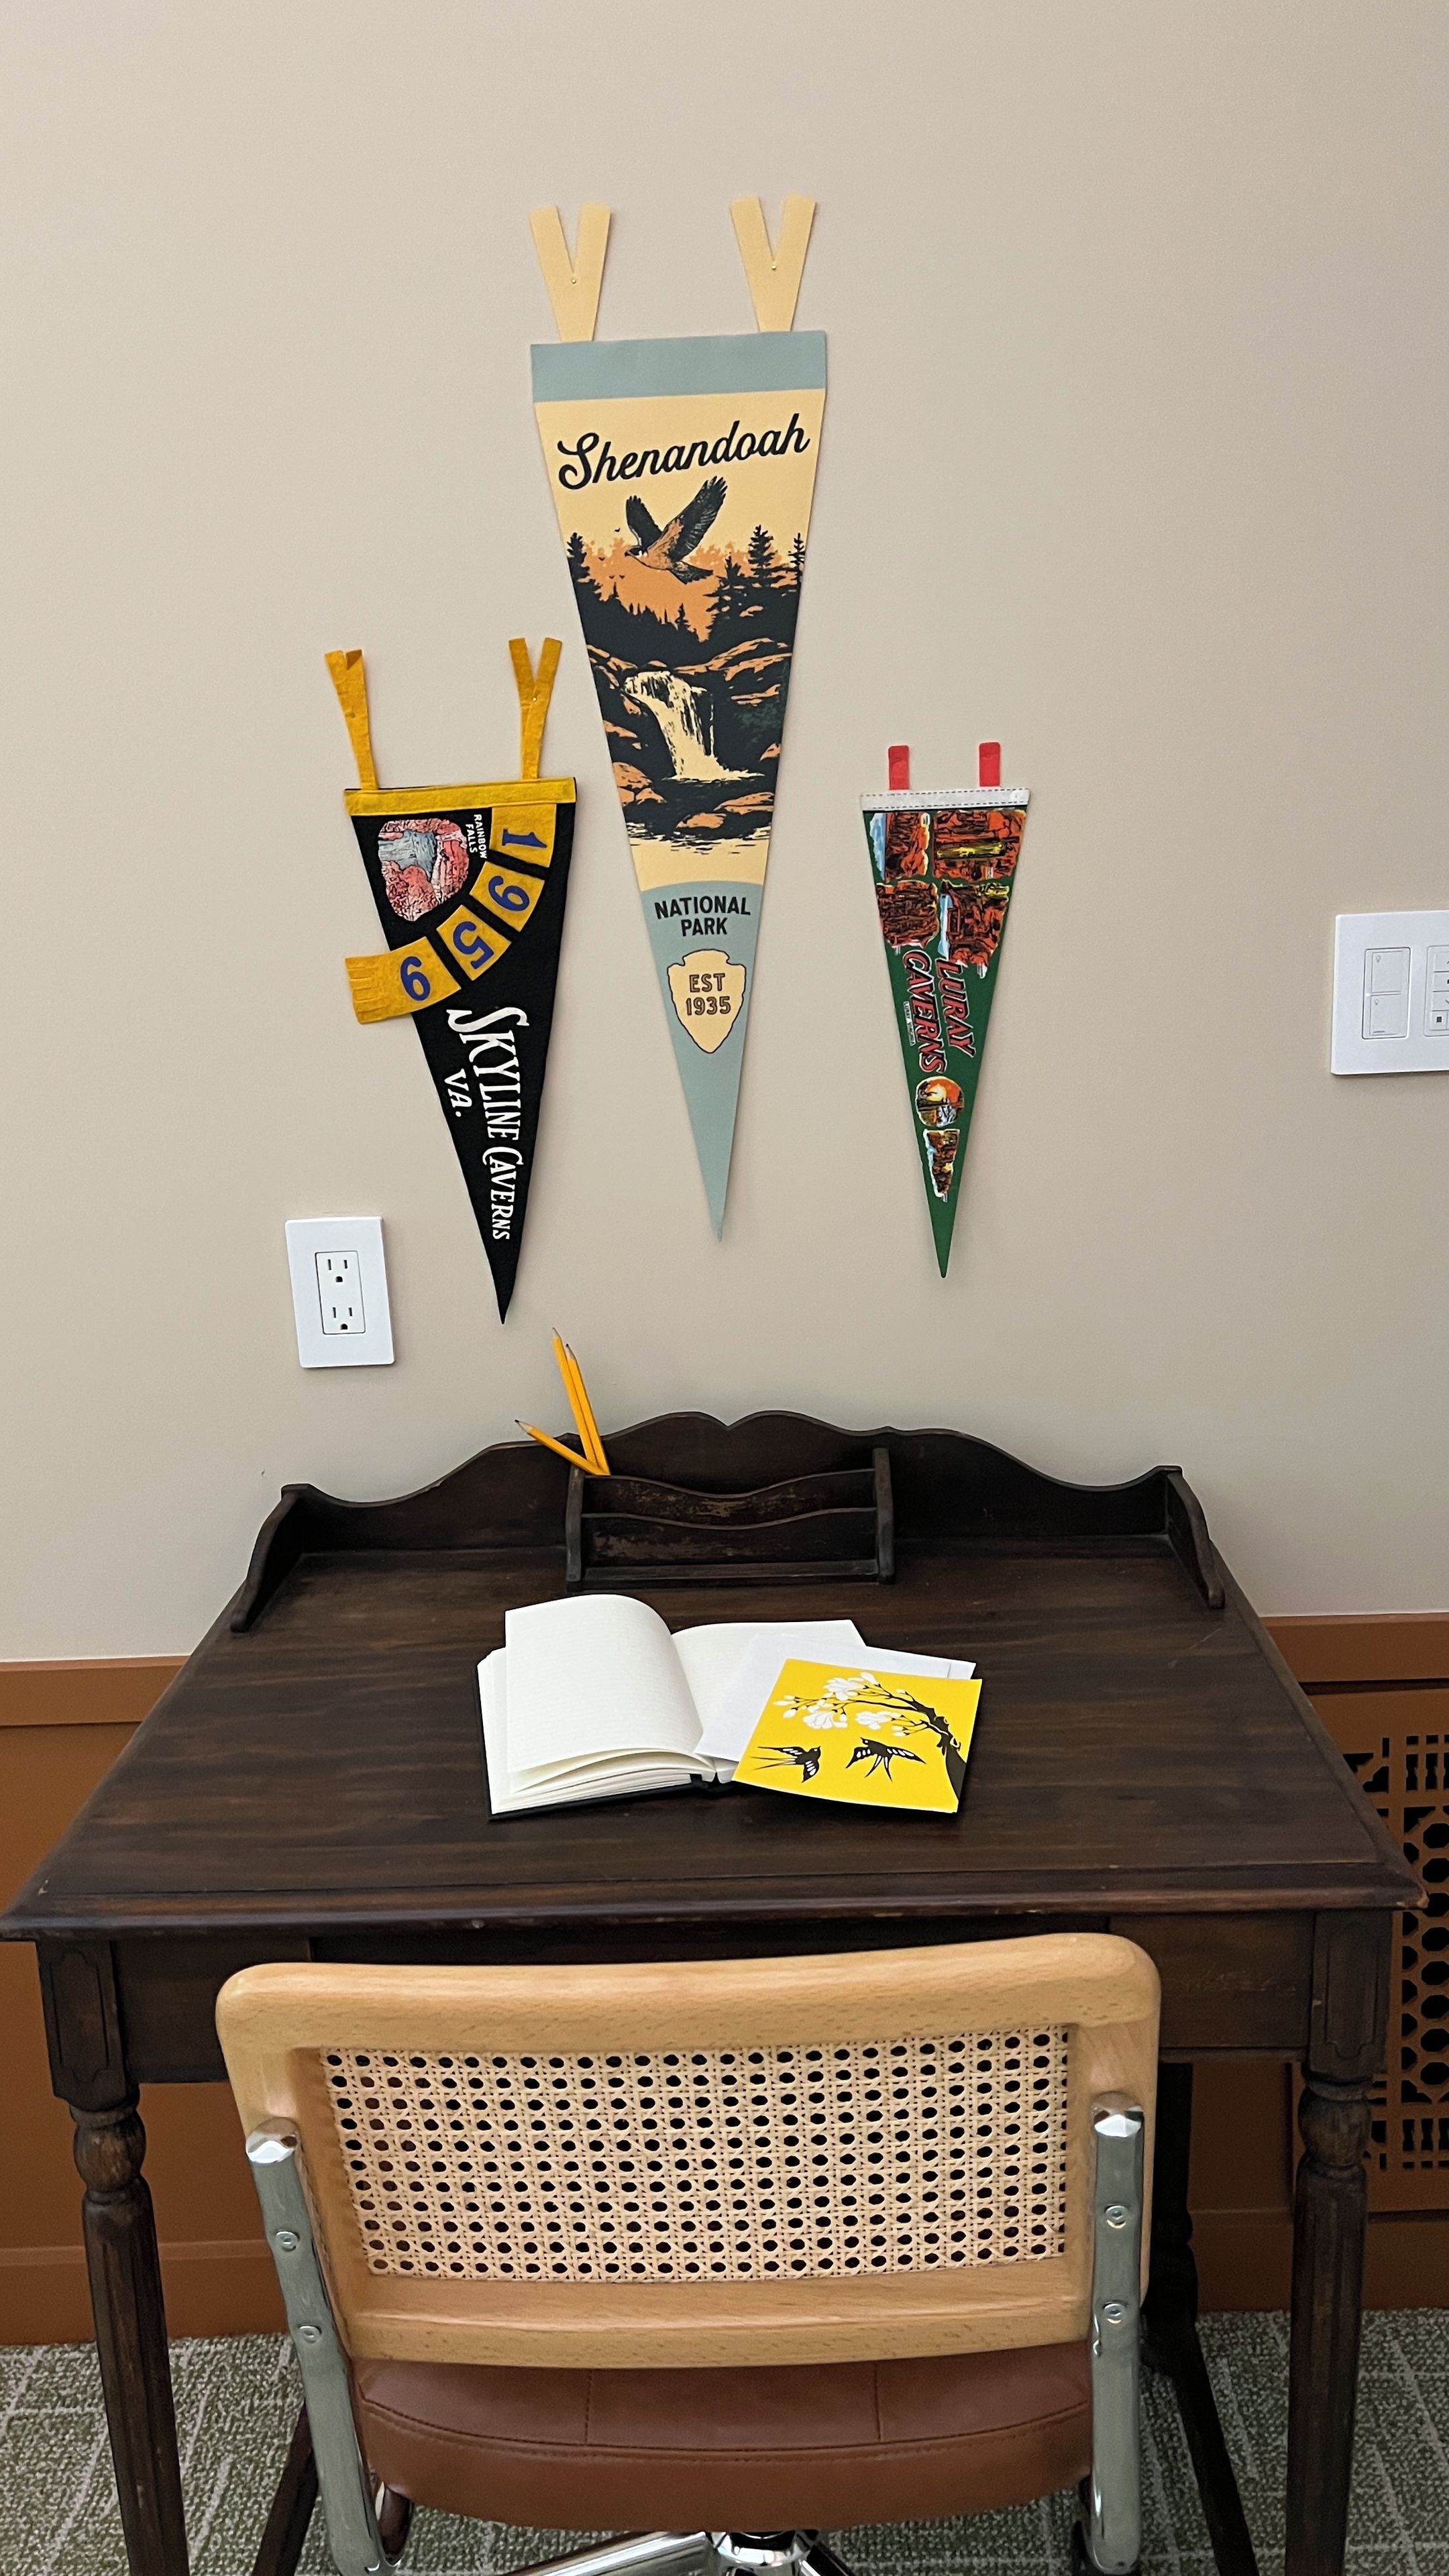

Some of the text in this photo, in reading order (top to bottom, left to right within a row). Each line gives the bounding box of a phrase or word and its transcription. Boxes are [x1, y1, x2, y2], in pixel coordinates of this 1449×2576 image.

[557, 413, 810, 490] Shenandoah
[465, 823, 477, 853] FALLS
[474, 814, 488, 859] RAINBOW
[654, 896, 751, 919] NATIONAL
[681, 917, 728, 936] PARK
[689, 973, 725, 992] EST
[686, 996, 731, 1016] 1935
[903, 949, 947, 1073] CAVERNS
[935, 958, 976, 1059] LURAY
[444, 1068, 472, 1117] VA.
[446, 1007, 529, 1240] SKYLINE CAVERNS
